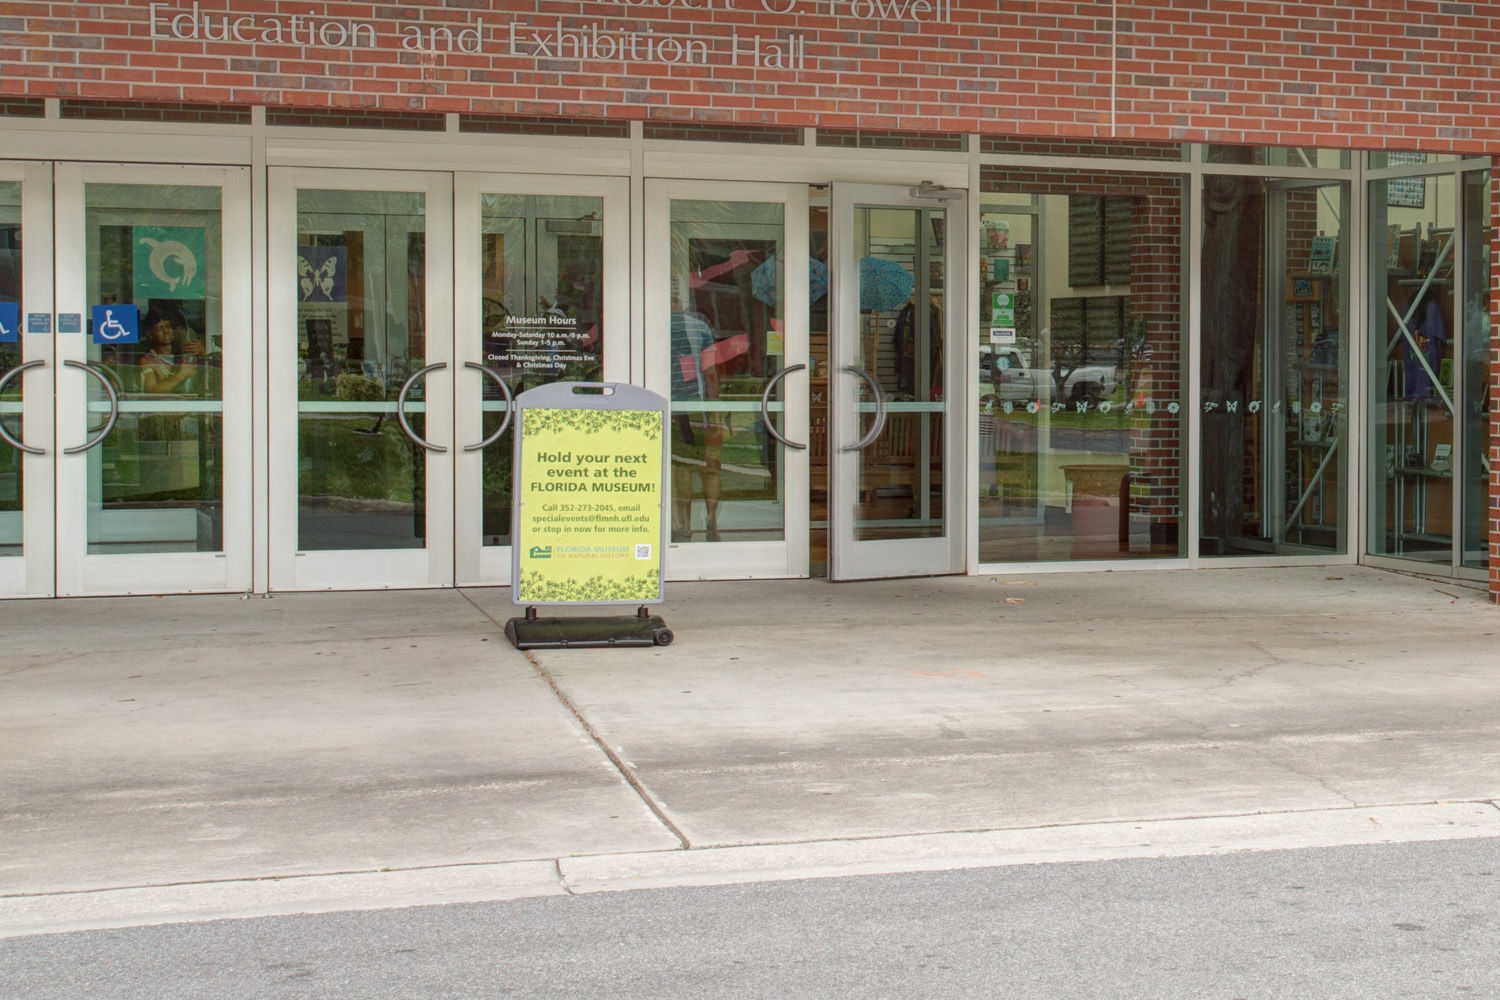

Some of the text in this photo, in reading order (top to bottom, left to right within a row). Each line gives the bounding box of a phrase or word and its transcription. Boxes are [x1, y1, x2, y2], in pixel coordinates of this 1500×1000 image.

[149, 1, 804, 70] Education and Exhibition Hall
[506, 315, 577, 325] Museum Hours
[537, 451, 648, 466] Hold your next
[546, 467, 638, 478] event at the
[530, 482, 656, 492] FLORIDA MUSEUM!
[542, 504, 558, 512] Call
[618, 504, 640, 512] email
[543, 526, 562, 534] stop
